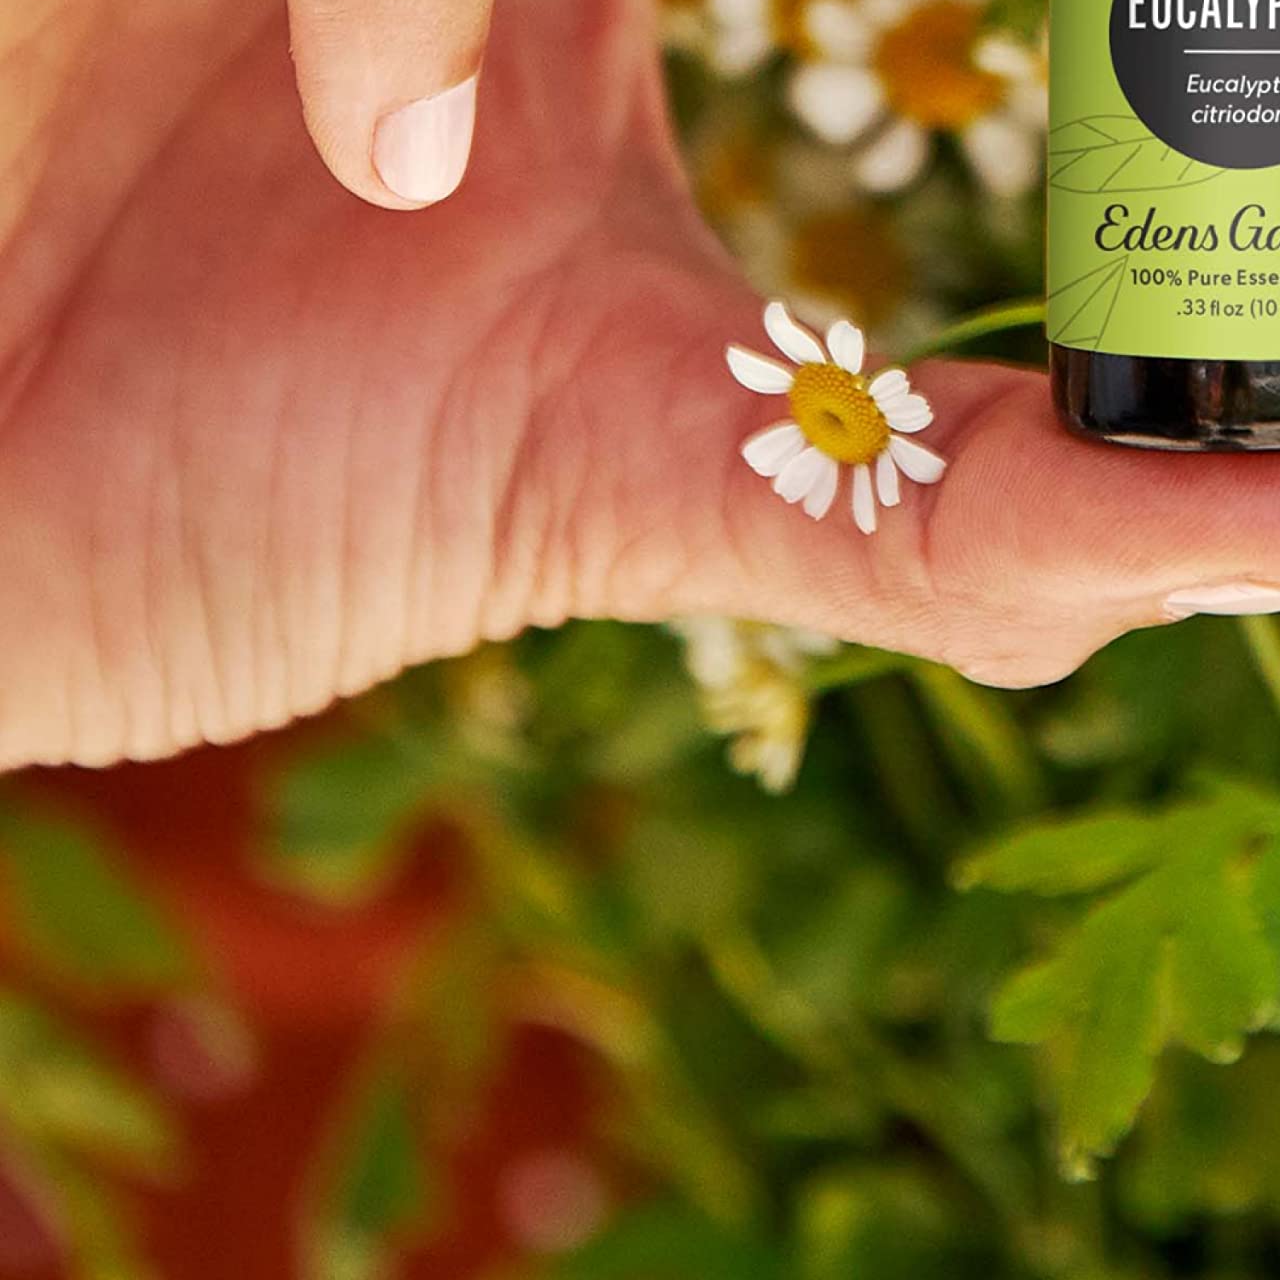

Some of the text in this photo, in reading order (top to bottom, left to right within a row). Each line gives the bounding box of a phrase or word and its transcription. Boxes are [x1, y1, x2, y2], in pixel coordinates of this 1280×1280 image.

[1094, 203, 1219, 252] Edens
[1130, 268, 1183, 287] 100%
[1188, 269, 1232, 287] Pure
[1176, 299, 1206, 317] .33
[1249, 298, 1278, 320] (10
